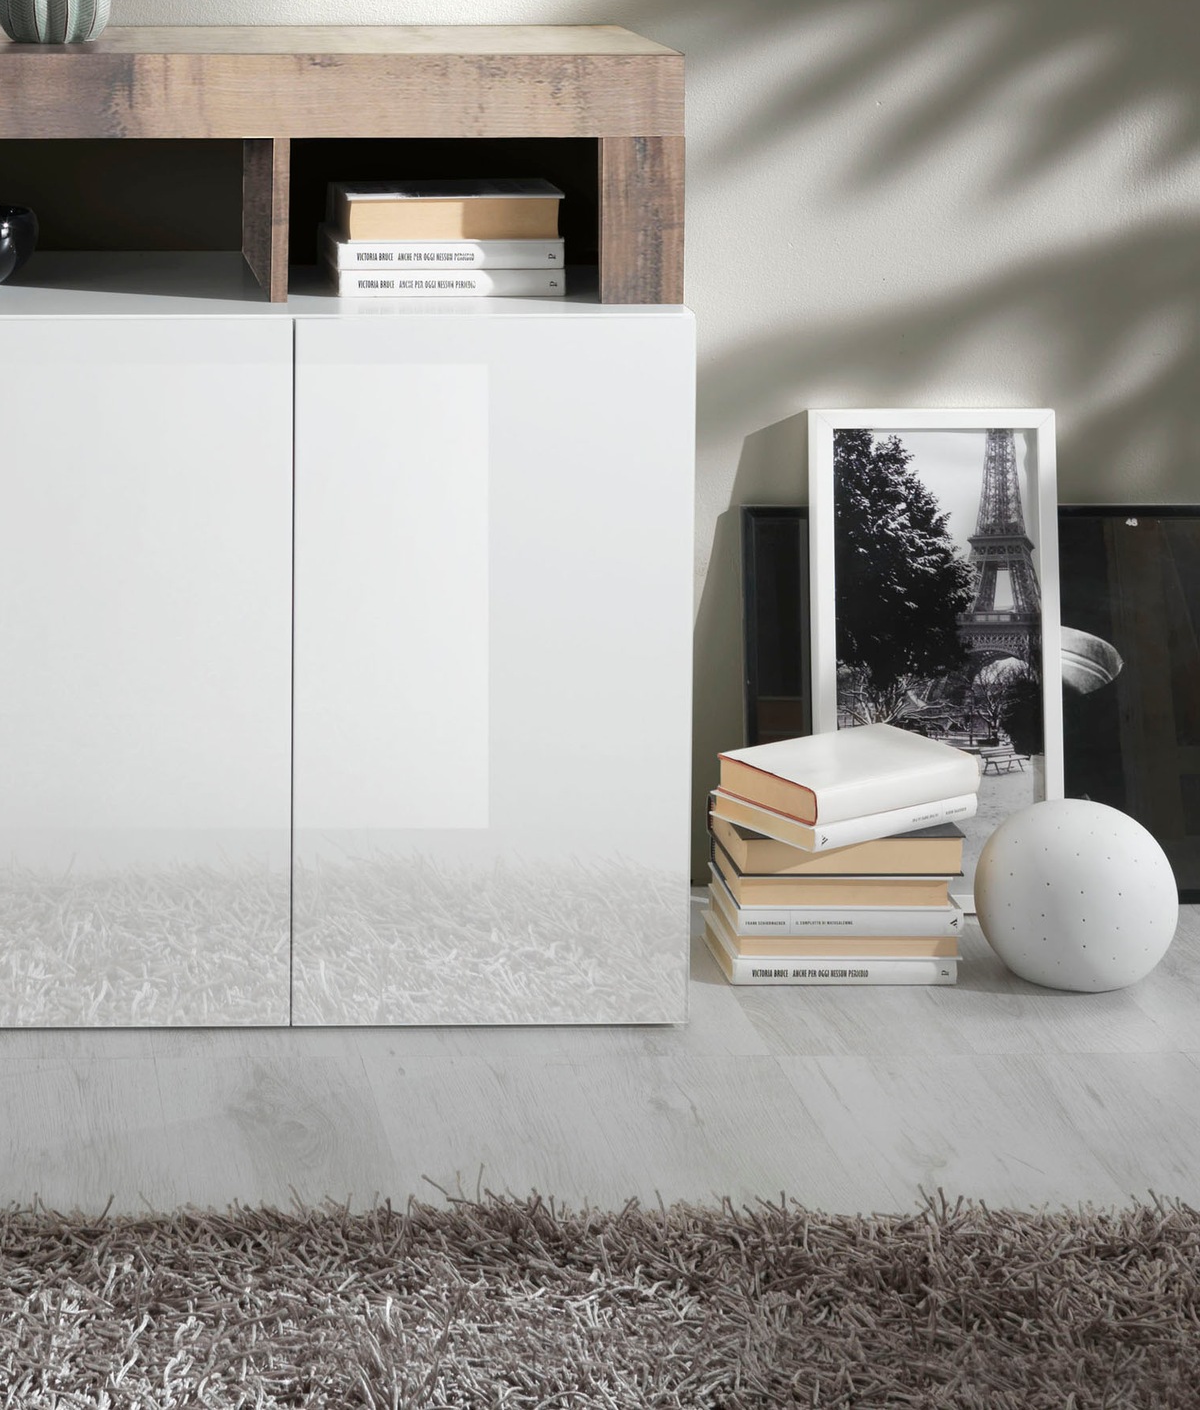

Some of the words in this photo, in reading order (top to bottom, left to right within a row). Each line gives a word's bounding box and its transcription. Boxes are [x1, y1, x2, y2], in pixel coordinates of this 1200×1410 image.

[357, 252, 378, 261] VICTORIA
[379, 252, 393, 261] BRUCE
[397, 252, 412, 261] ANCHE
[358, 280, 379, 289] VICTORIA
[380, 280, 395, 289] BRUCE
[1125, 518, 1138, 527] 48
[752, 969, 773, 978] VICTORIA
[774, 969, 788, 978] BRUCE
[792, 969, 807, 978] ANCHE
[808, 969, 817, 978] PER
[818, 969, 829, 978] OGGI
